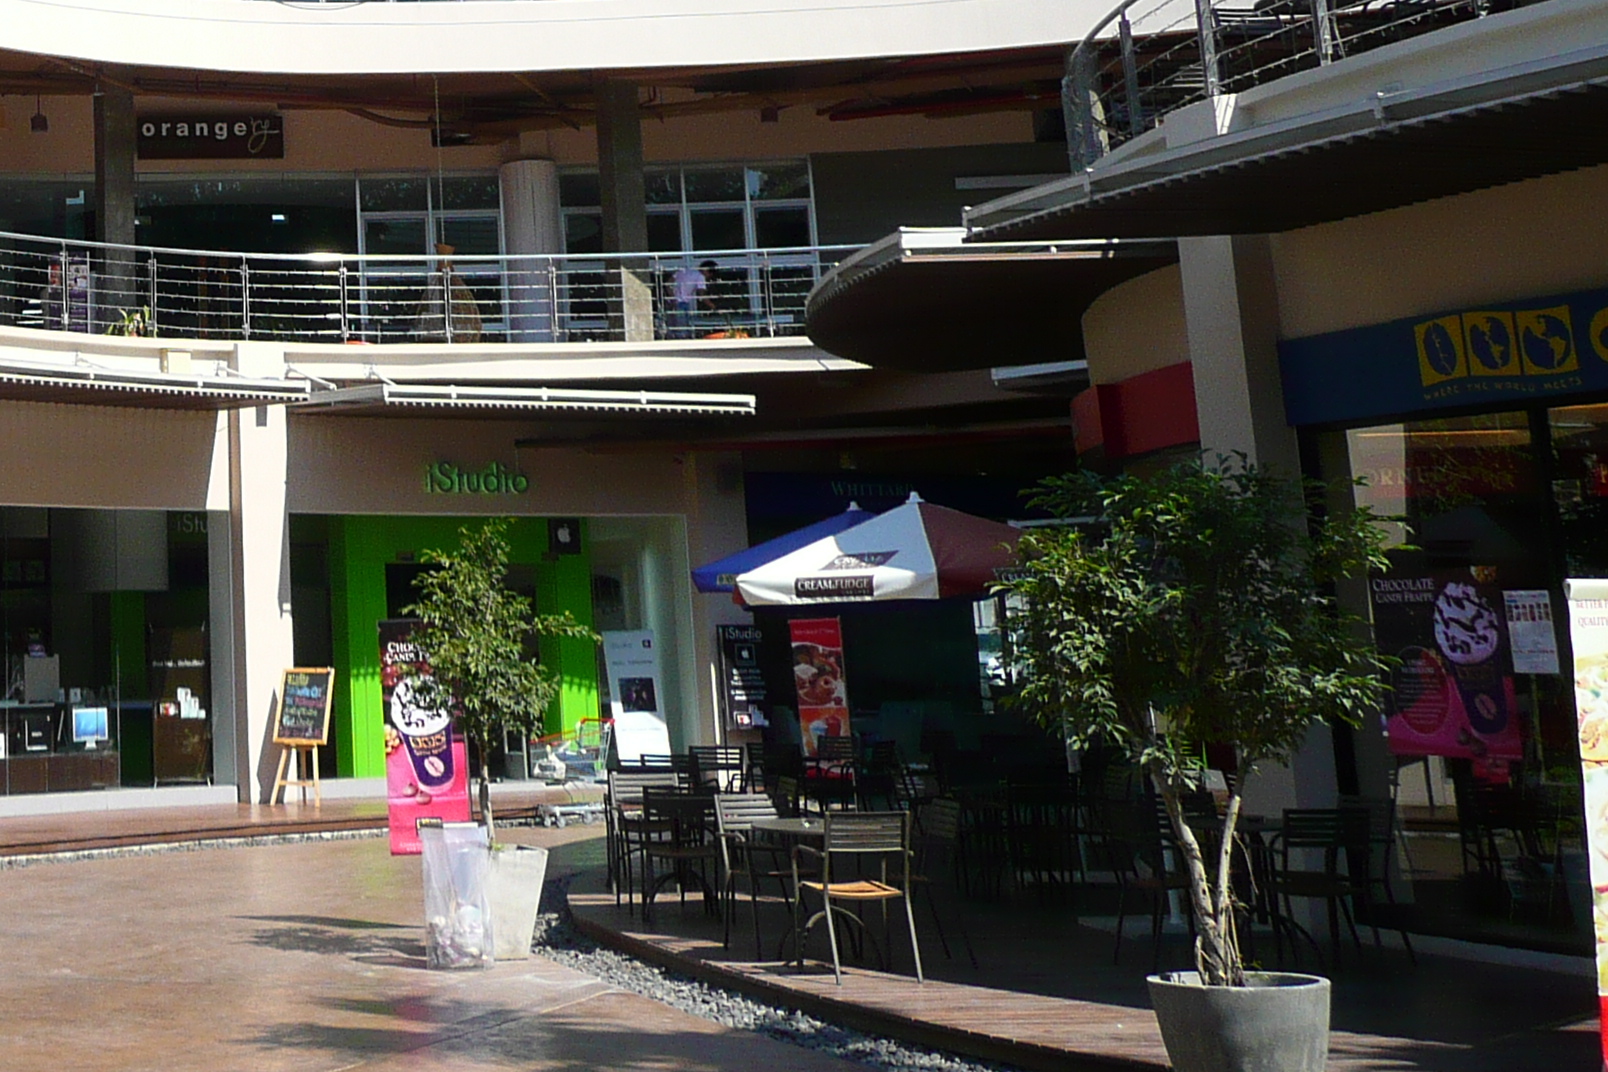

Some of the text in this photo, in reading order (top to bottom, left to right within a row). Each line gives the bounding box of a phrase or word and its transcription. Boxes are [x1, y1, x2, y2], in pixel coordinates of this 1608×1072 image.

[1467, 381, 1490, 392] THE
[425, 461, 529, 494] iStudio
[177, 513, 207, 533] iStu
[1373, 577, 1435, 592] CHOCOLATE
[724, 626, 763, 640] iStudio
